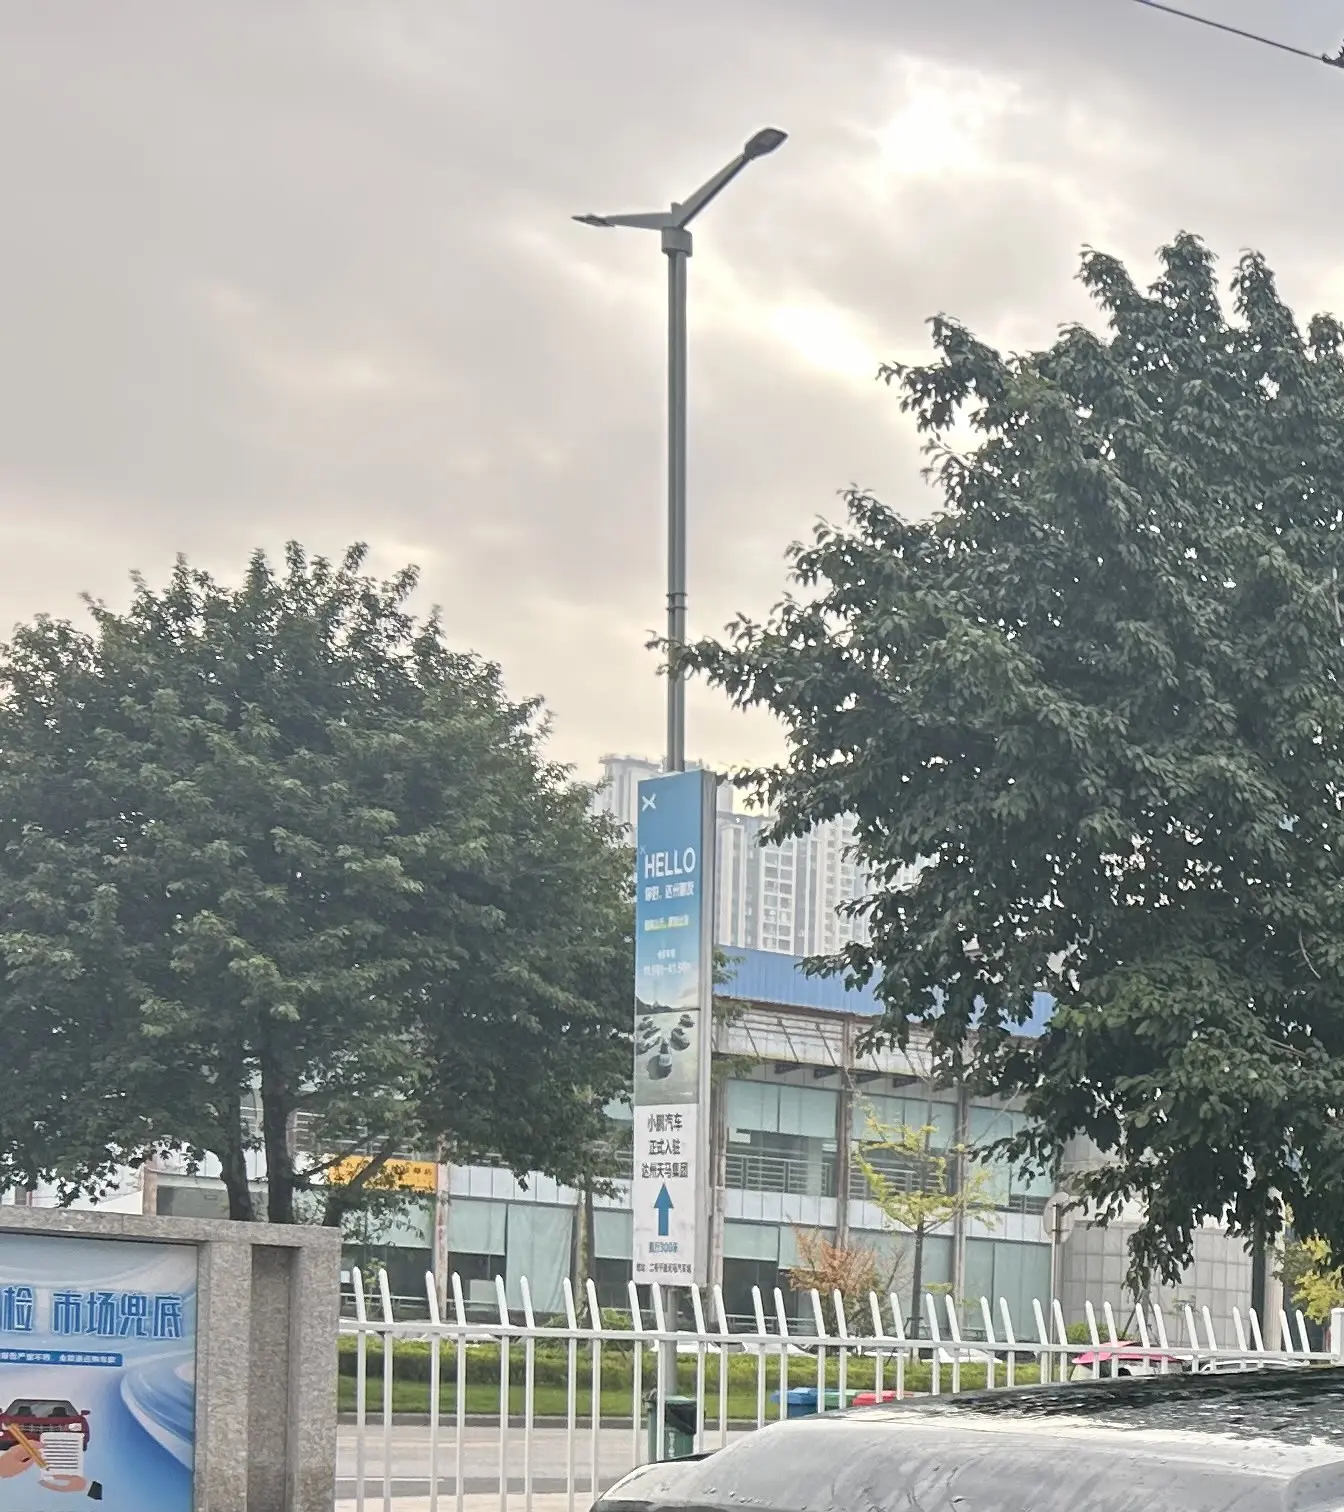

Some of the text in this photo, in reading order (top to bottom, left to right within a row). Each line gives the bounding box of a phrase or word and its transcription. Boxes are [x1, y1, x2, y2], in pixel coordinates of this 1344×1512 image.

[644, 846, 697, 880] HELLO
[648, 1138, 681, 1156] 正式入驻
[641, 1162, 689, 1179] 达州天马集团
[2, 1286, 183, 1338] 检 市场兜底
